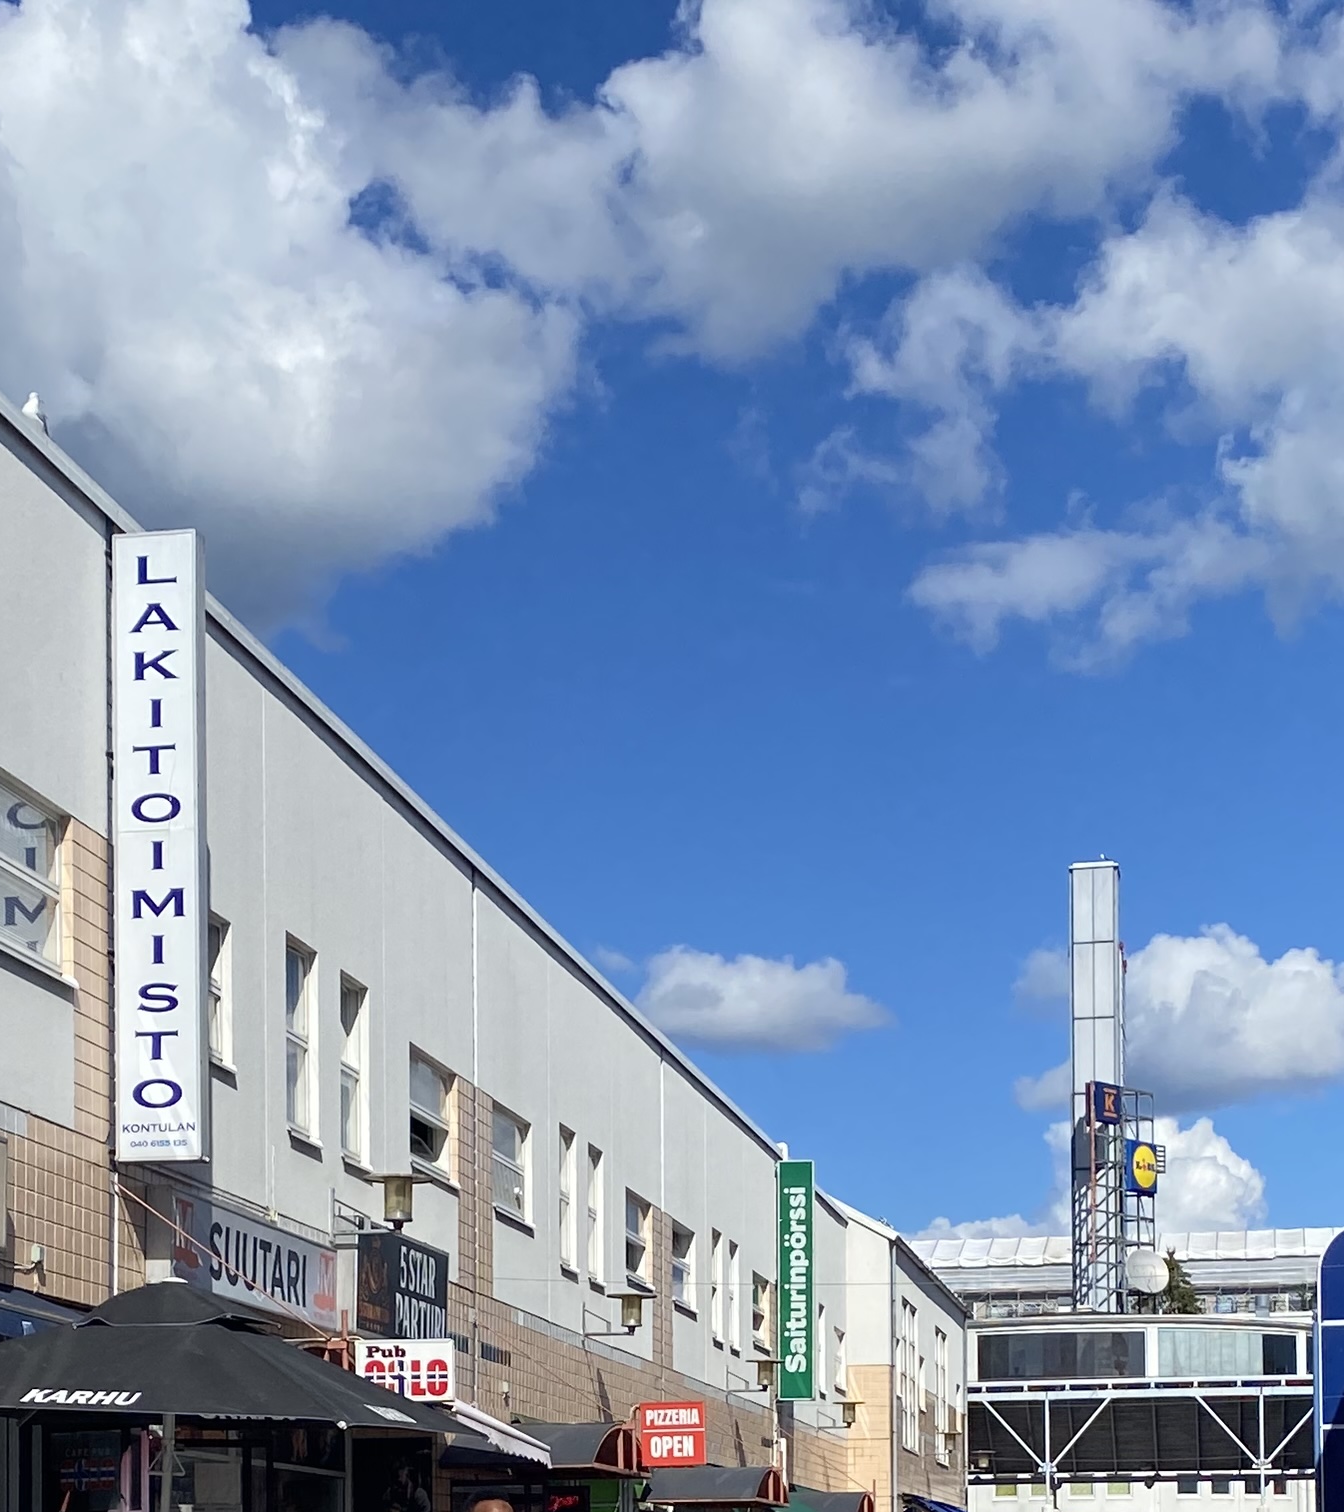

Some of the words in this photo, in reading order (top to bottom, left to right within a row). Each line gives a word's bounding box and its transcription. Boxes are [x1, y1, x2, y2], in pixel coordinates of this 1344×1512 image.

[129, 555, 185, 1109] LAKITOIMISTO
[122, 1122, 196, 1134] KONTULAN
[209, 1221, 307, 1308] SUUTARI
[408, 1248, 436, 1300] STAR
[783, 1186, 810, 1373] Saiturinpörssi
[395, 1291, 445, 1339] PARTURI
[366, 1345, 406, 1358] Pub
[364, 1359, 448, 1396] OSLO
[19, 1388, 143, 1406] KARHU
[645, 1408, 700, 1426] PIZZERIA
[650, 1435, 694, 1458] OPEN
